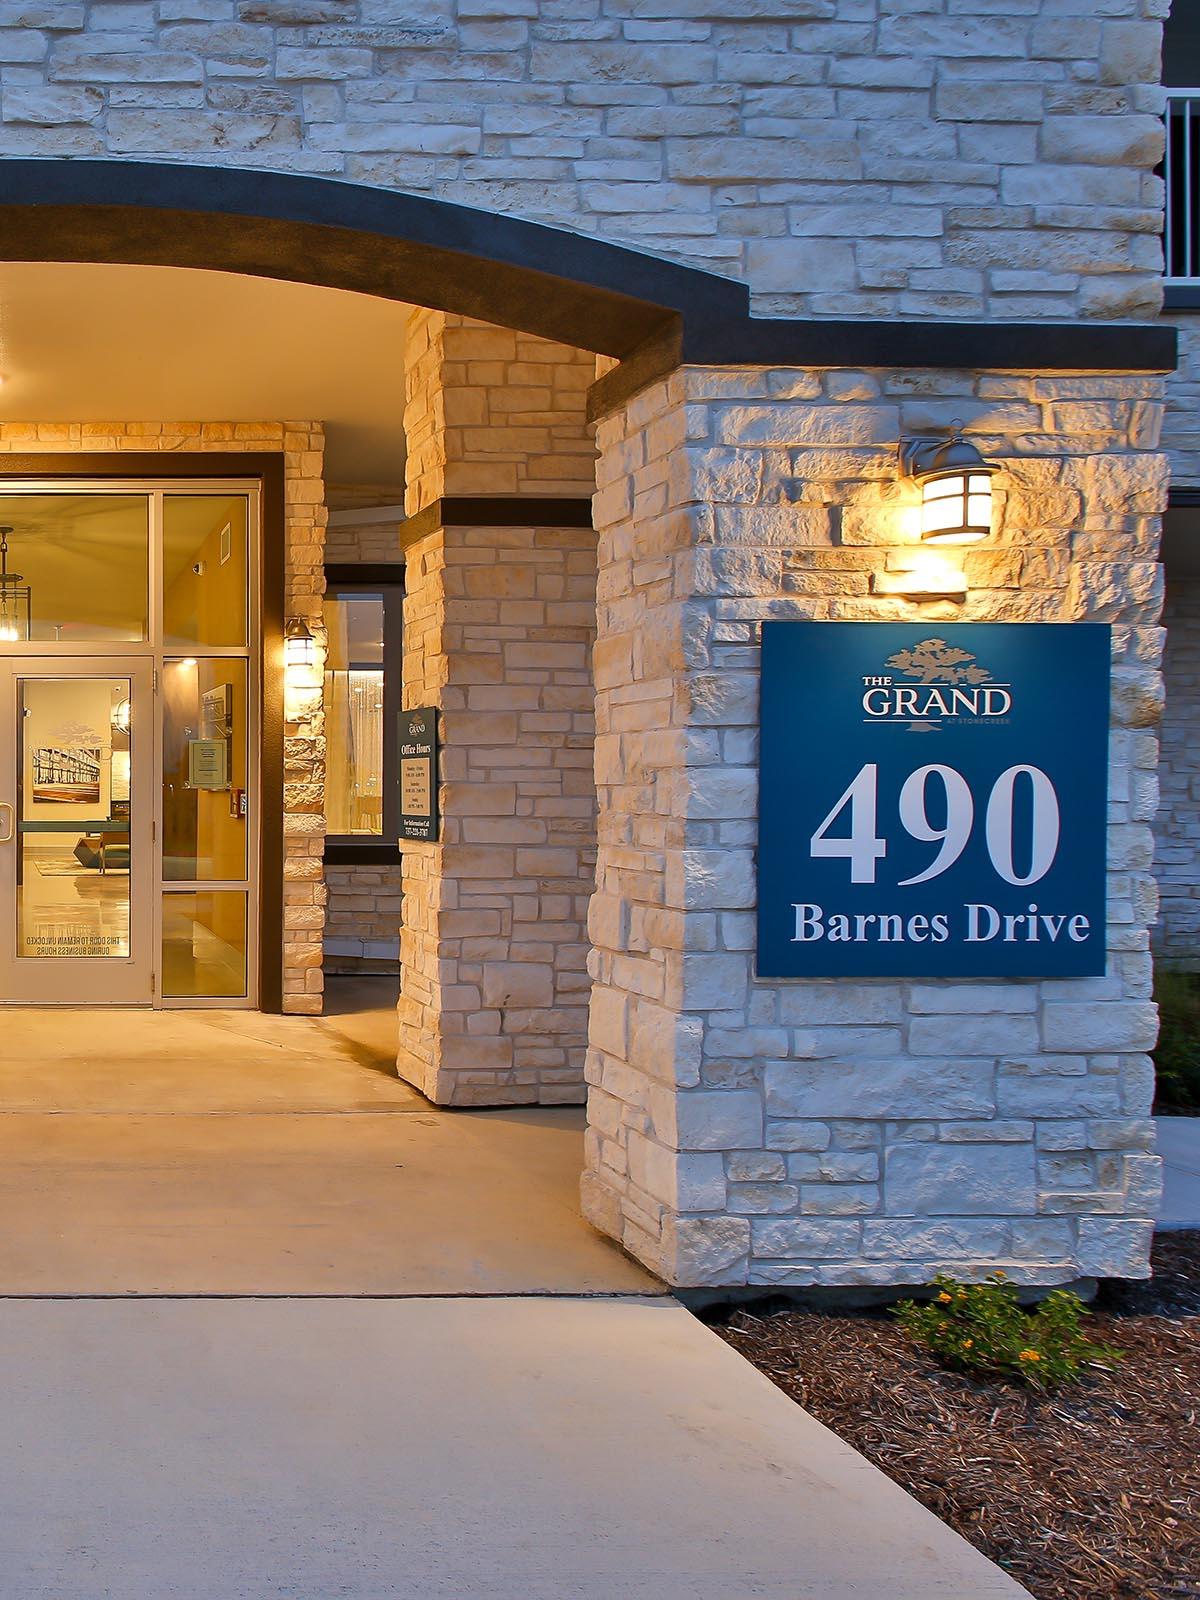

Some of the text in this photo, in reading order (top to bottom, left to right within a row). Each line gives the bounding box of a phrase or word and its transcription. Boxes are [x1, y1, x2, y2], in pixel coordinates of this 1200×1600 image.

[862, 676, 892, 686] THE
[862, 688, 1011, 716] GRAND
[401, 743, 431, 755] Office Hours
[810, 763, 1060, 887] 490
[790, 903, 1090, 942] Barnes Drive
